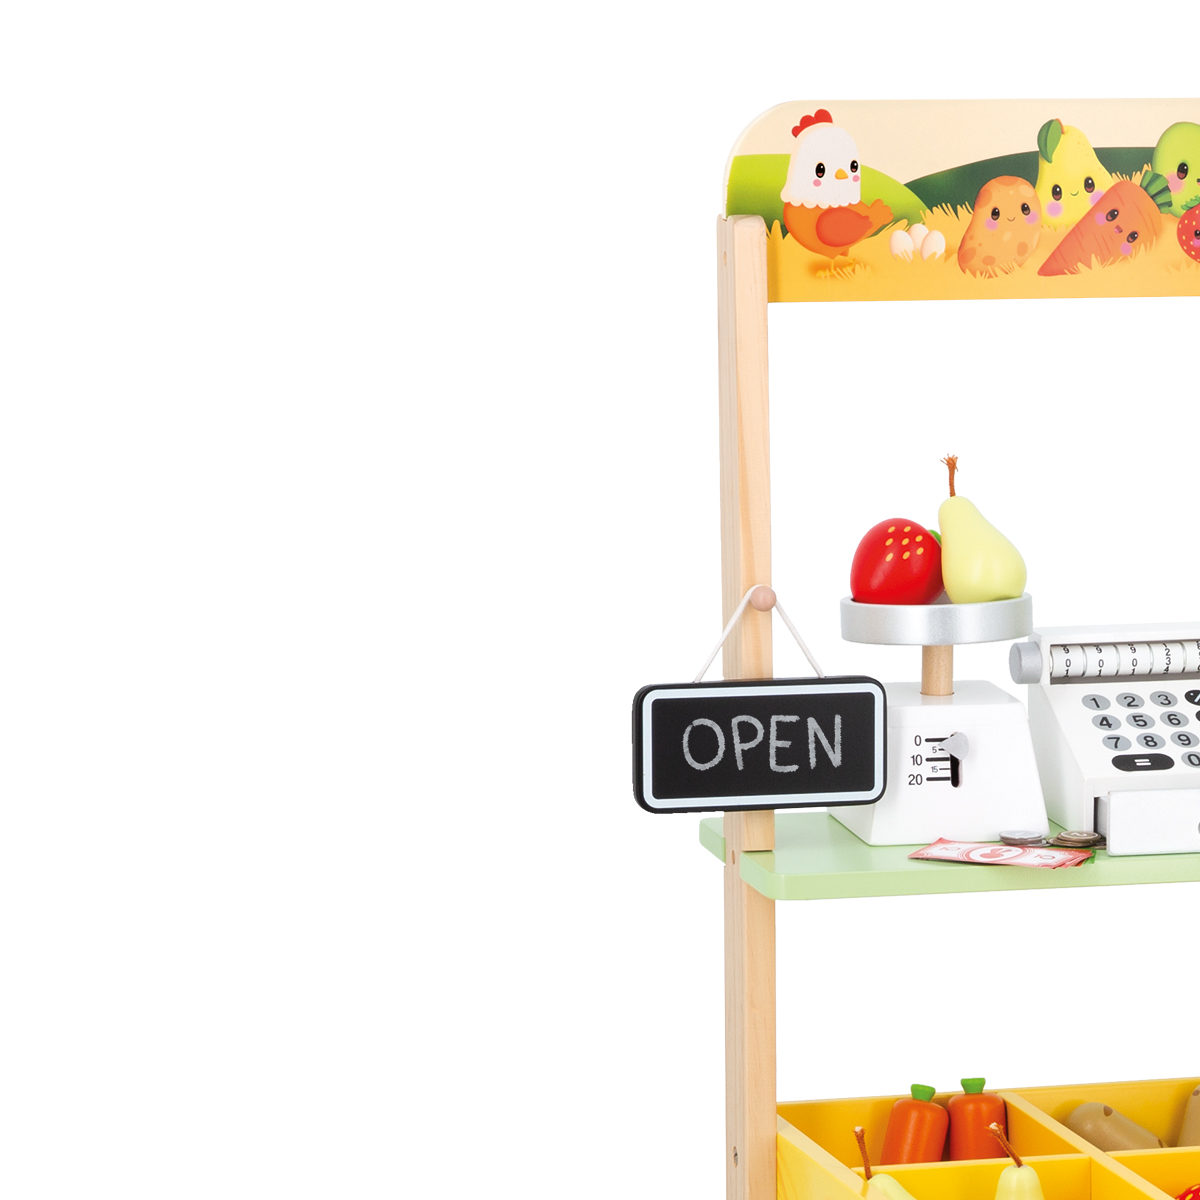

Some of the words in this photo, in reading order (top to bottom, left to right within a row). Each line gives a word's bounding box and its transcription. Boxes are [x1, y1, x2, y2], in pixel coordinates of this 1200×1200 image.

[1065, 659, 1071, 667] 0
[1098, 659, 1104, 668] 0
[1132, 658, 1138, 667] 0
[1089, 697, 1100, 708] 1
[1123, 695, 1139, 707] 2
[1157, 694, 1172, 705] 3
[1099, 716, 1113, 729] 4
[1132, 715, 1148, 727] 5
[1167, 713, 1181, 726] 6
[682, 714, 842, 773] OPEN
[914, 735, 922, 747] 0
[1107, 736, 1121, 749] 7
[1143, 735, 1158, 747] 8
[1177, 734, 1192, 746] 9
[931, 746, 938, 754] 5
[910, 754, 923, 766] 10
[908, 773, 923, 786] 20
